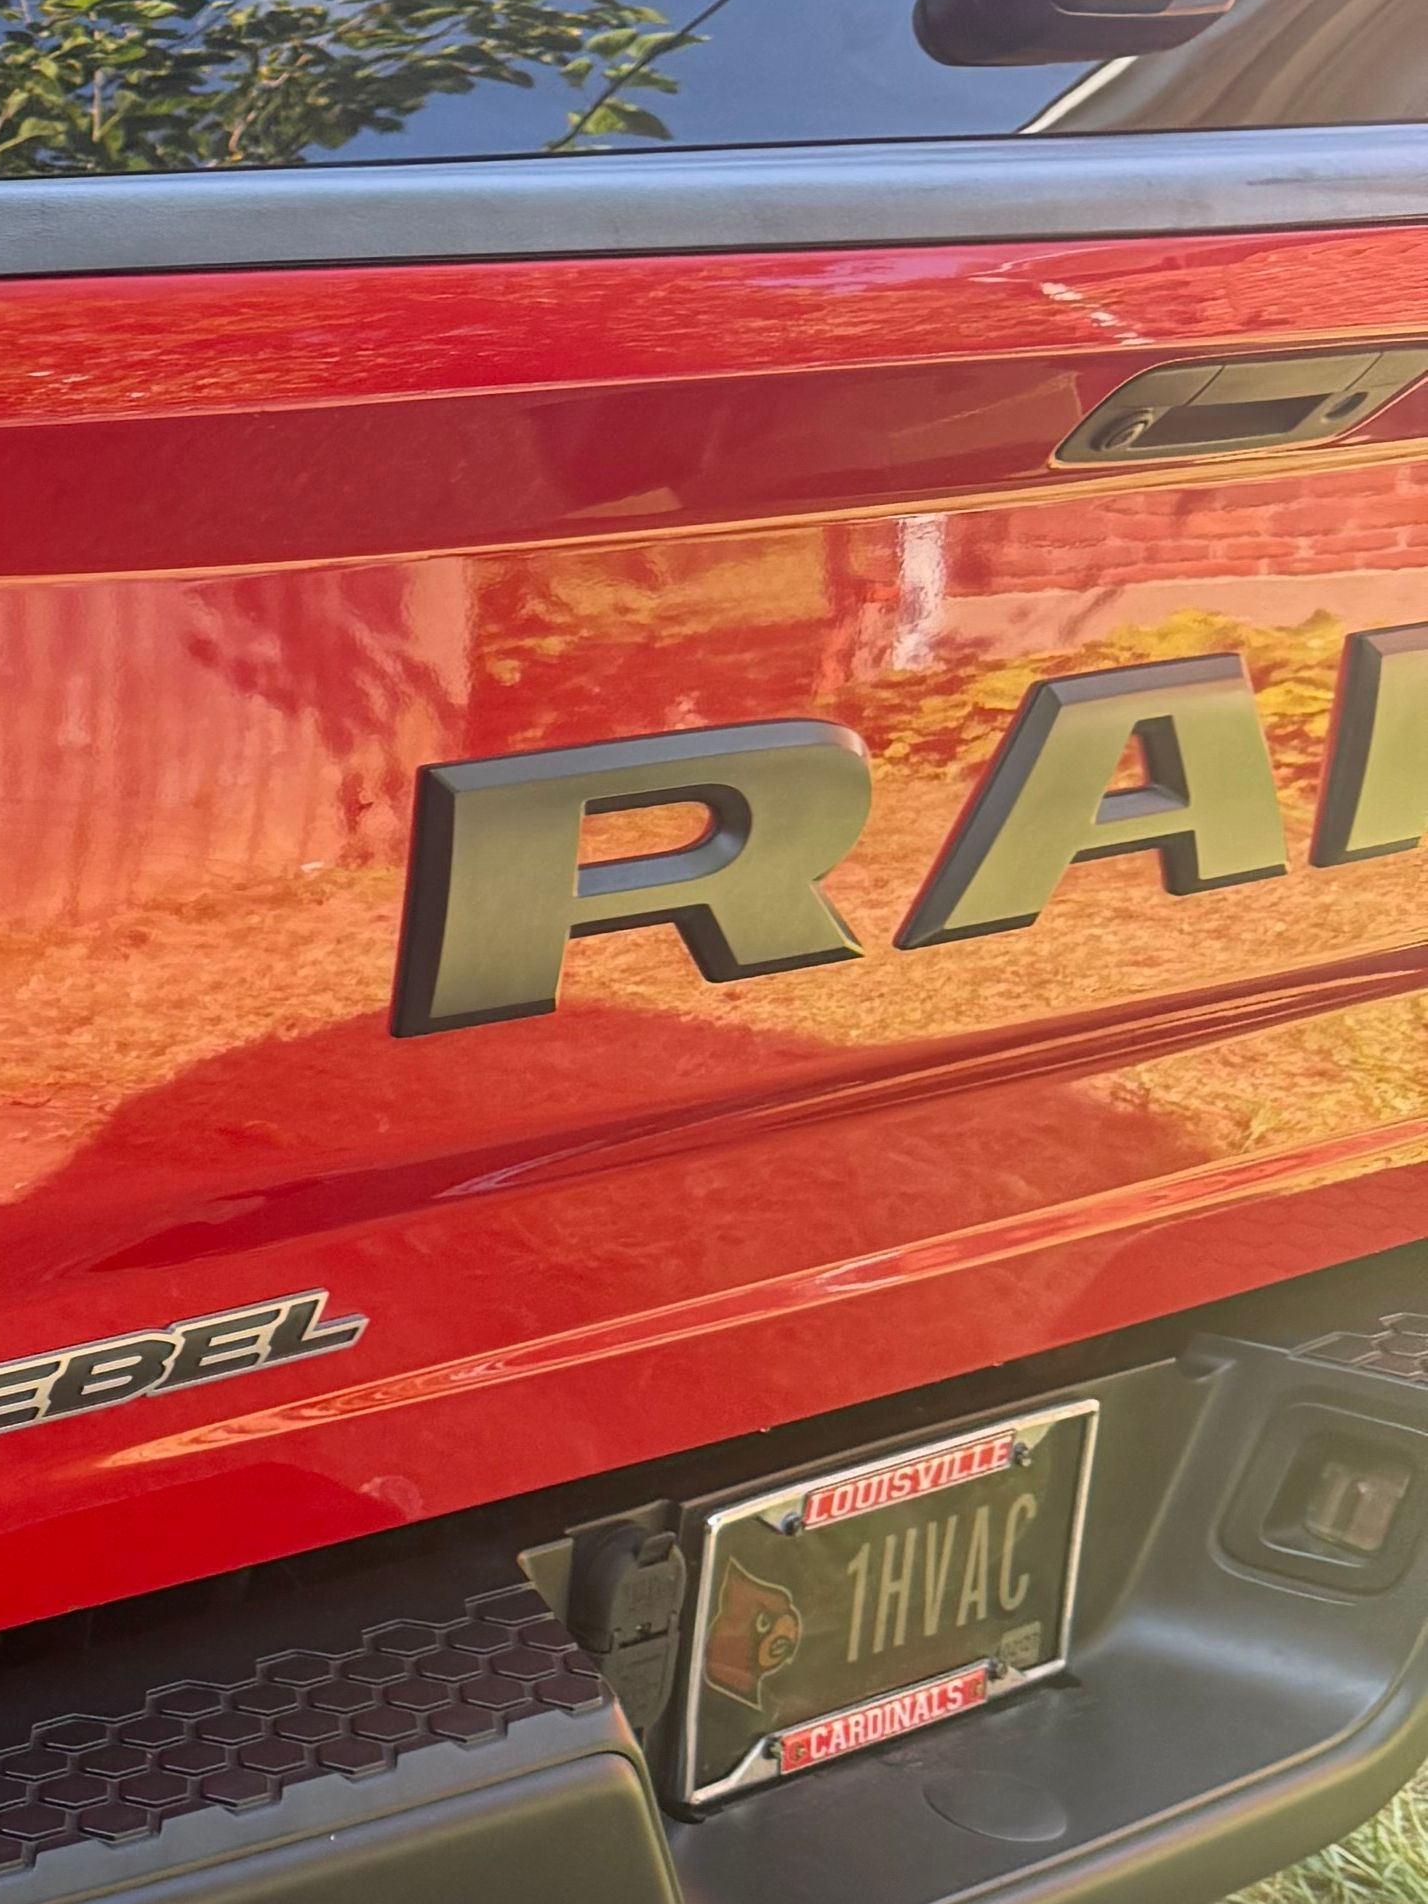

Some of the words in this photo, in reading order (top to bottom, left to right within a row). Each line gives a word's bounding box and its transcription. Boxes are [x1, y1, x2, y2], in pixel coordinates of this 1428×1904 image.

[389, 621, 1428, 1038] RA
[806, 1435, 1013, 1525] LOUISVILLE
[847, 1493, 1038, 1663] 1HVAC
[810, 1679, 964, 1760] CARDINALS
